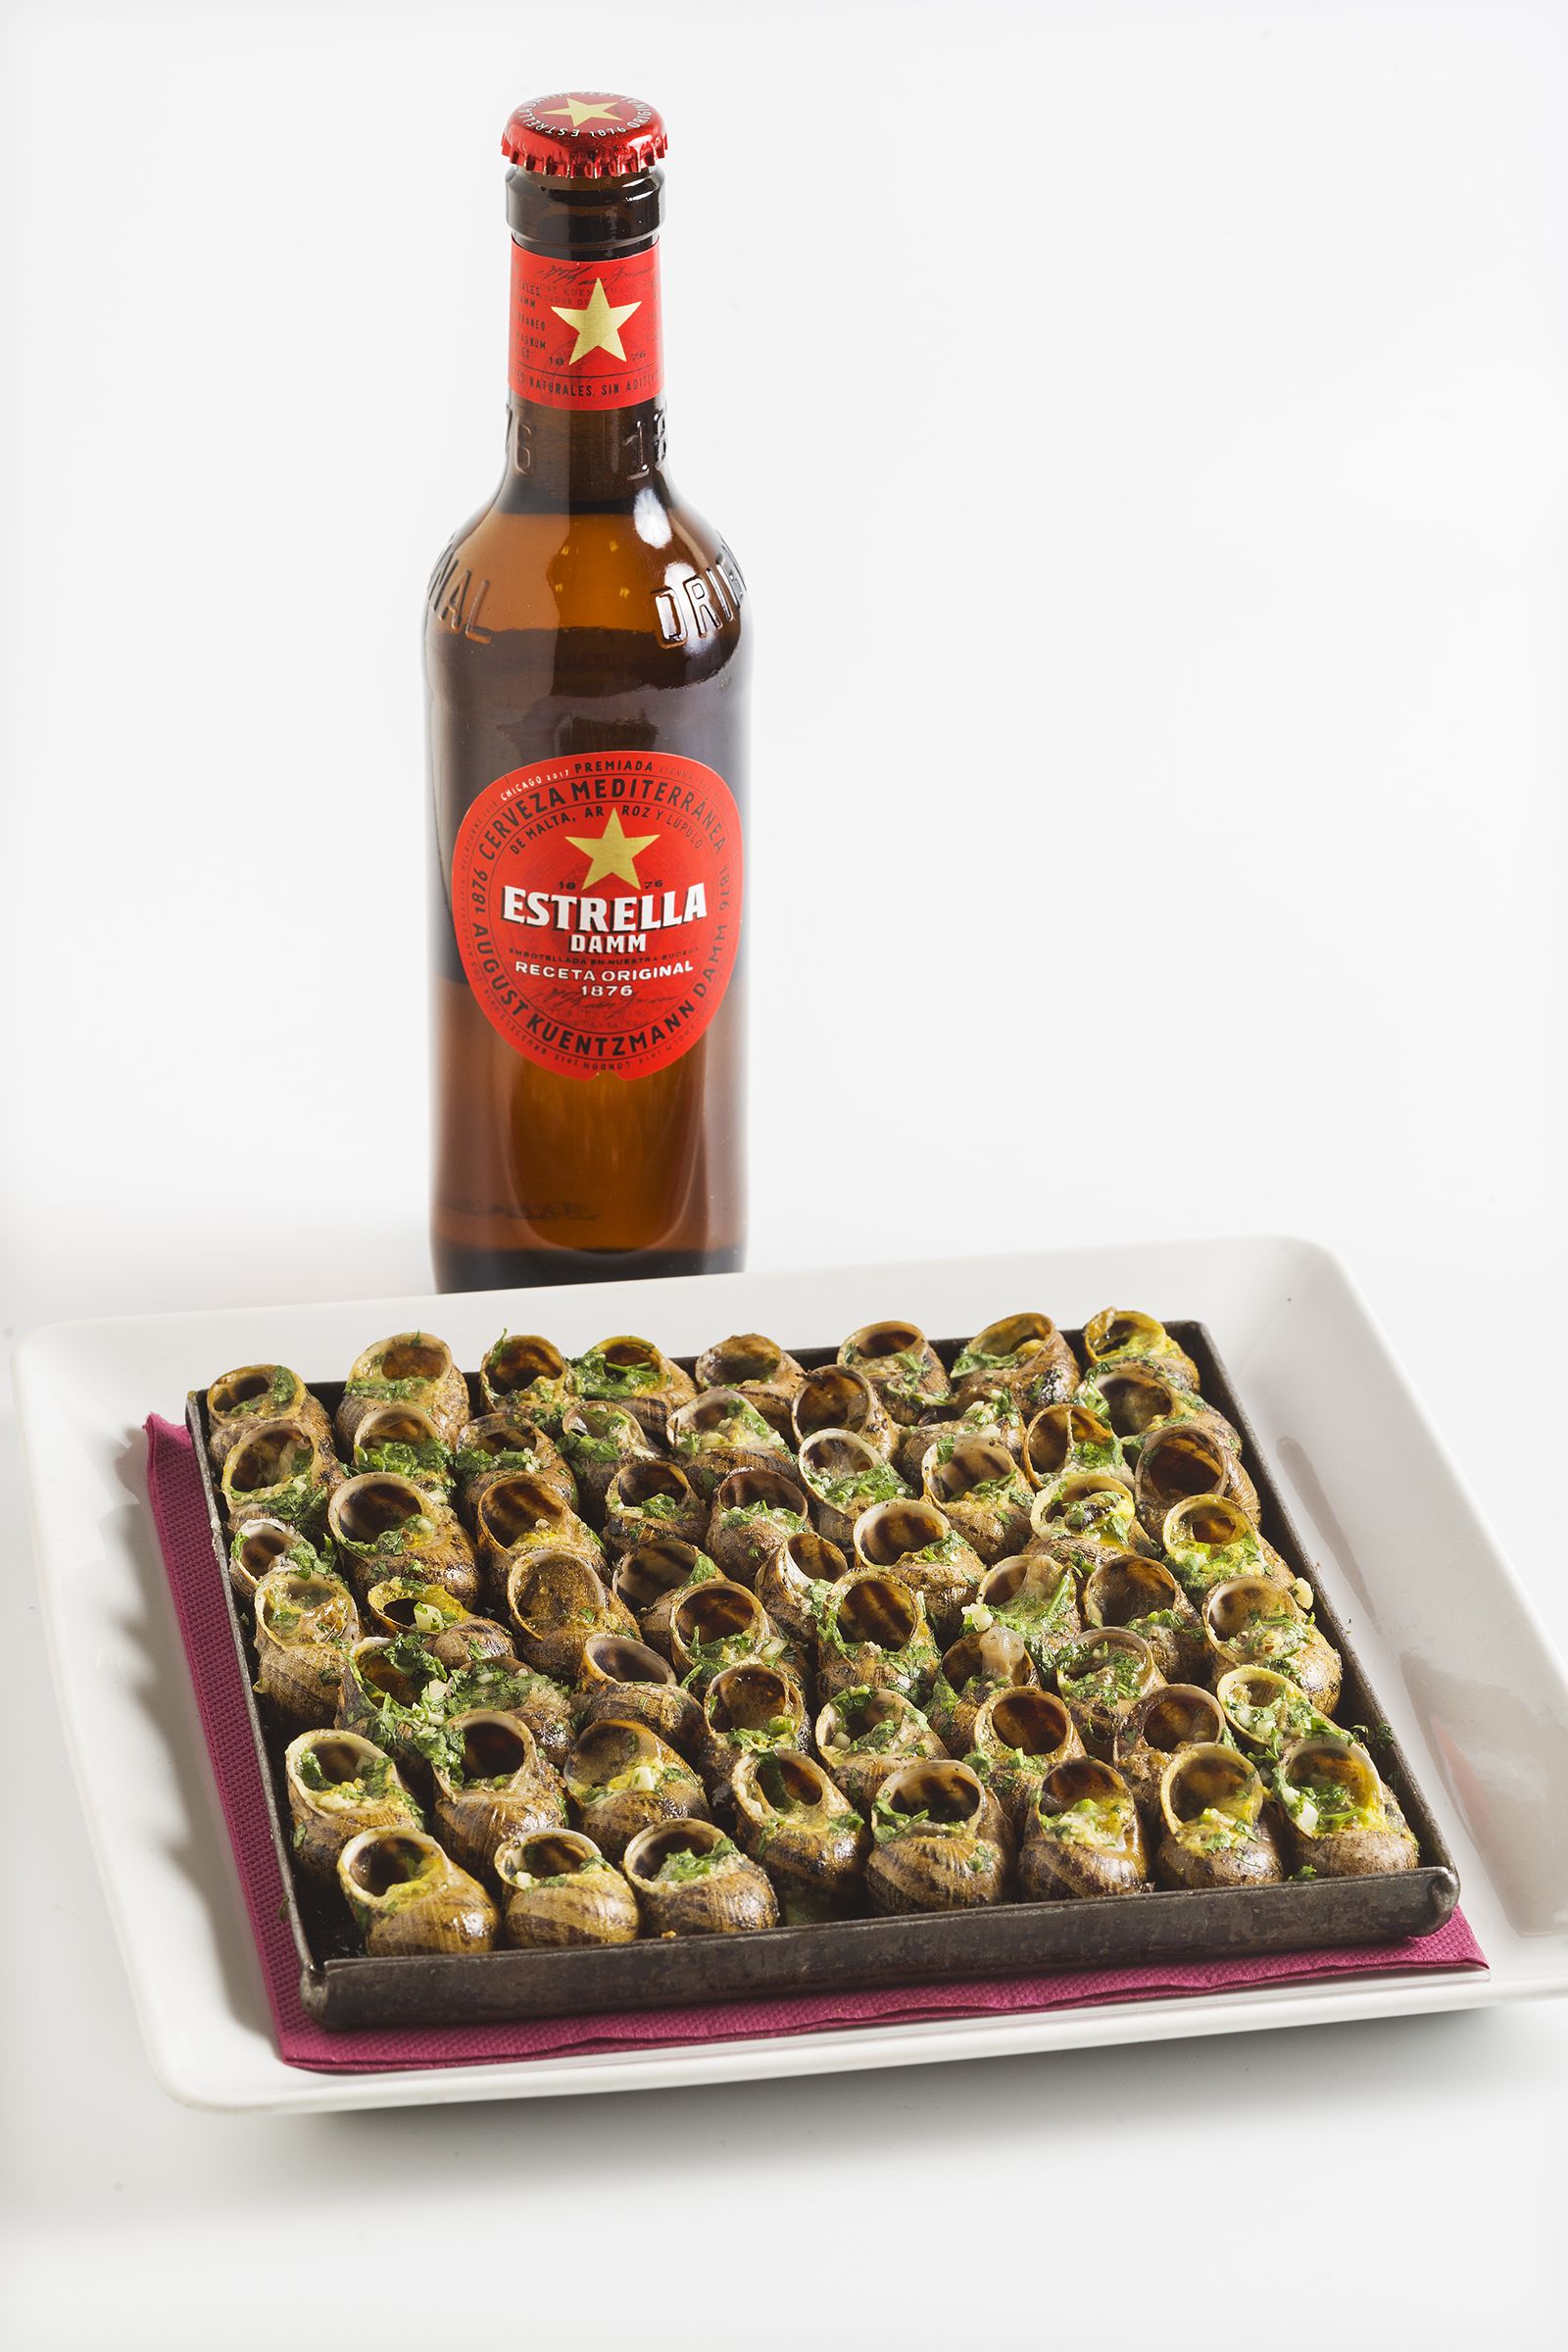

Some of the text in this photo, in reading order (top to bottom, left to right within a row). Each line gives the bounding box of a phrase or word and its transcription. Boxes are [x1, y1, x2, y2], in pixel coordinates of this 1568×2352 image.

[602, 384, 619, 397] SIN
[500, 775, 542, 802] CHICAGO
[546, 769, 569, 782] 2017
[574, 760, 653, 774] PREMIADA
[478, 787, 566, 860] CERVEZA
[510, 838, 526, 856] DE
[525, 812, 576, 841] MALTA,
[656, 809, 663, 821] Y
[471, 867, 488, 914] 1876
[502, 882, 708, 934] ESTRELLA
[568, 933, 647, 956] DAMM
[472, 922, 529, 1015] AUGUST
[526, 1000, 695, 1056] KUENTZMANN
[693, 924, 728, 998] DAMM
[515, 959, 694, 982] RECETA ORIGINAL
[581, 985, 633, 997] 1876
[583, 1060, 631, 1070] LONDON
